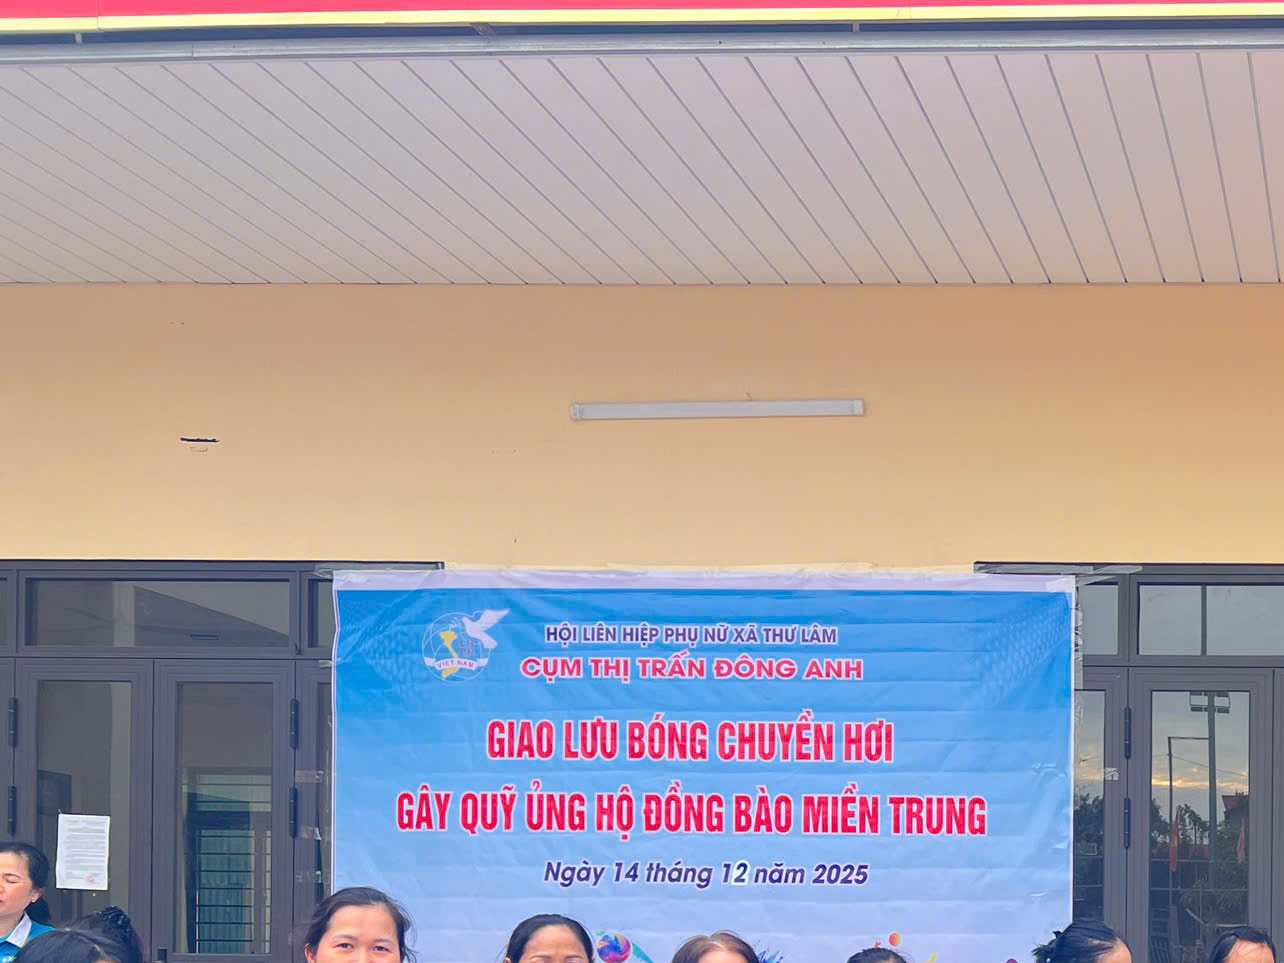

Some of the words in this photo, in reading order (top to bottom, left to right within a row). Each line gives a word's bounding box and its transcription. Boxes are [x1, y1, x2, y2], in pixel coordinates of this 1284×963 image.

[546, 623, 577, 647] HỘI
[582, 623, 616, 643] LIÊN
[622, 623, 659, 647] HIỆP
[664, 626, 698, 647] PHỤ
[704, 623, 729, 643] NỮ
[733, 623, 758, 643] XÃ
[763, 626, 797, 643] THƯ
[801, 623, 837, 643] LÂM
[521, 658, 581, 682] CỤM
[590, 658, 629, 682] THỊ
[637, 650, 704, 679] TRẤN
[714, 655, 796, 679] ĐÔNG
[804, 658, 863, 680] ANH
[487, 720, 554, 759] GIAO
[564, 716, 619, 760] LƯU
[628, 712, 707, 760] BÓNG
[717, 710, 834, 761] CHUYỀN
[843, 719, 893, 762] HƠI
[397, 784, 451, 831] GÂY
[460, 785, 517, 834] QUỸ
[526, 780, 586, 831] ỦNG
[596, 785, 634, 841] HỘ
[643, 781, 724, 832] ĐỒNG
[734, 786, 792, 833] BÀO
[803, 782, 879, 833] MIỀN
[888, 796, 987, 835] TRUNG
[544, 860, 604, 887] Ngày
[614, 862, 639, 882] 14
[645, 859, 712, 888] tháng
[723, 863, 749, 884] 12
[754, 863, 805, 884] năm
[812, 864, 868, 884] 2025
